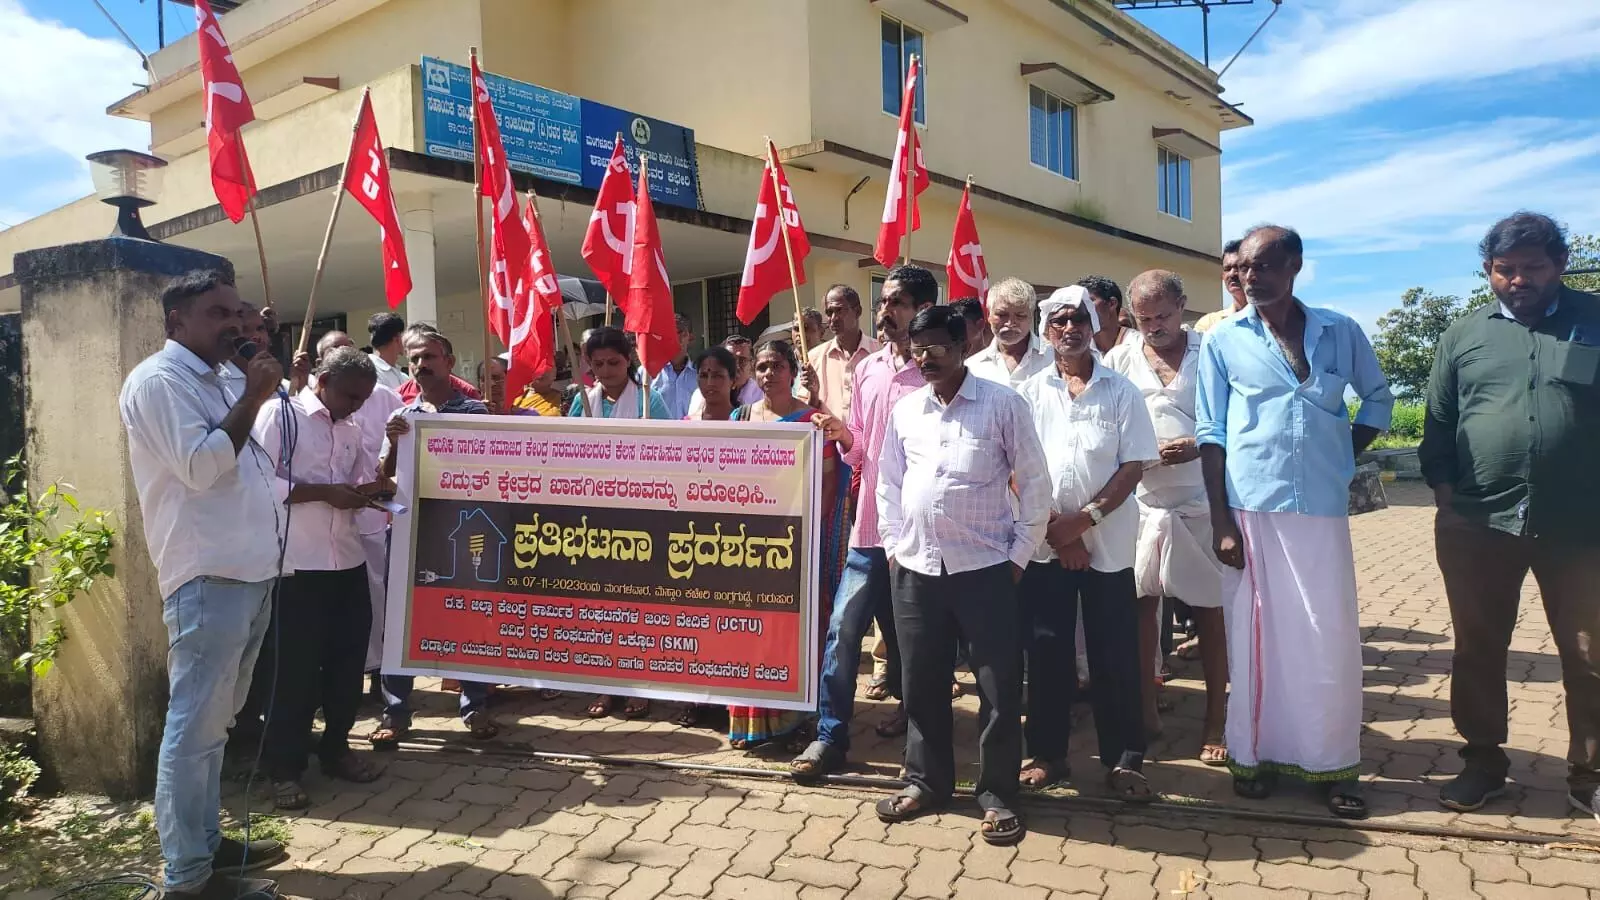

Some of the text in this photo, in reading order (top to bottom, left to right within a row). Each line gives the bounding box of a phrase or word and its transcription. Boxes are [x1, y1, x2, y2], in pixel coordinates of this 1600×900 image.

[458, 438, 486, 455] ನಾಗರಿಕ
[490, 438, 522, 457] ಸಮಾಜದ
[526, 437, 548, 464] ಕೇಂದ್ರ
[616, 440, 636, 461] ಕೆಲಸ
[640, 441, 682, 462] ನಿರ್ವಹಿಸುವ
[686, 443, 715, 473] ಅತ್ಯಂತ
[719, 443, 746, 471] ಪ್ರಮುಖ
[751, 444, 796, 466] ಸೇವೆಯಾದ
[439, 470, 777, 509] ವಿದ್ಯುತ್ ಕ್ಷೇತ್ರದ ಖಾಸಗೀಕರಣವನ್ನು ವಿರೋಧಿಸಿ...
[513, 512, 794, 580] ಪ್ರತಿಭಟನಾ ಪ್ರದರ್ಶನ
[445, 596, 763, 635] ದ.ಕ. ಜಿಲ್ಲಾ ಕೇಂದ್ರ ಕಾರ್ಮಿಕ ಸಂಘಟನೆಗಳ ಜಂಟಿ ವೇದಿಕೆ (JCTU)
[756, 592, 794, 605] ಗುರುಪುರ
[500, 623, 699, 654] ವಿವಿಧ ರೈತ ಸಂಘಟನೆಗಳ ಒಕ್ಕೂಟ (SKM)
[420, 638, 788, 681] ವಿದ್ಯಾರ್ಥಿ ಯುವಜನ ಮಹಿಳಾ ದಲಿತ ಆದಿವಾಸಿ ಹಾಗೂ ಜನಪರ ಸಂಘಟನೆಗಳ ವೇದಿಕೆ
